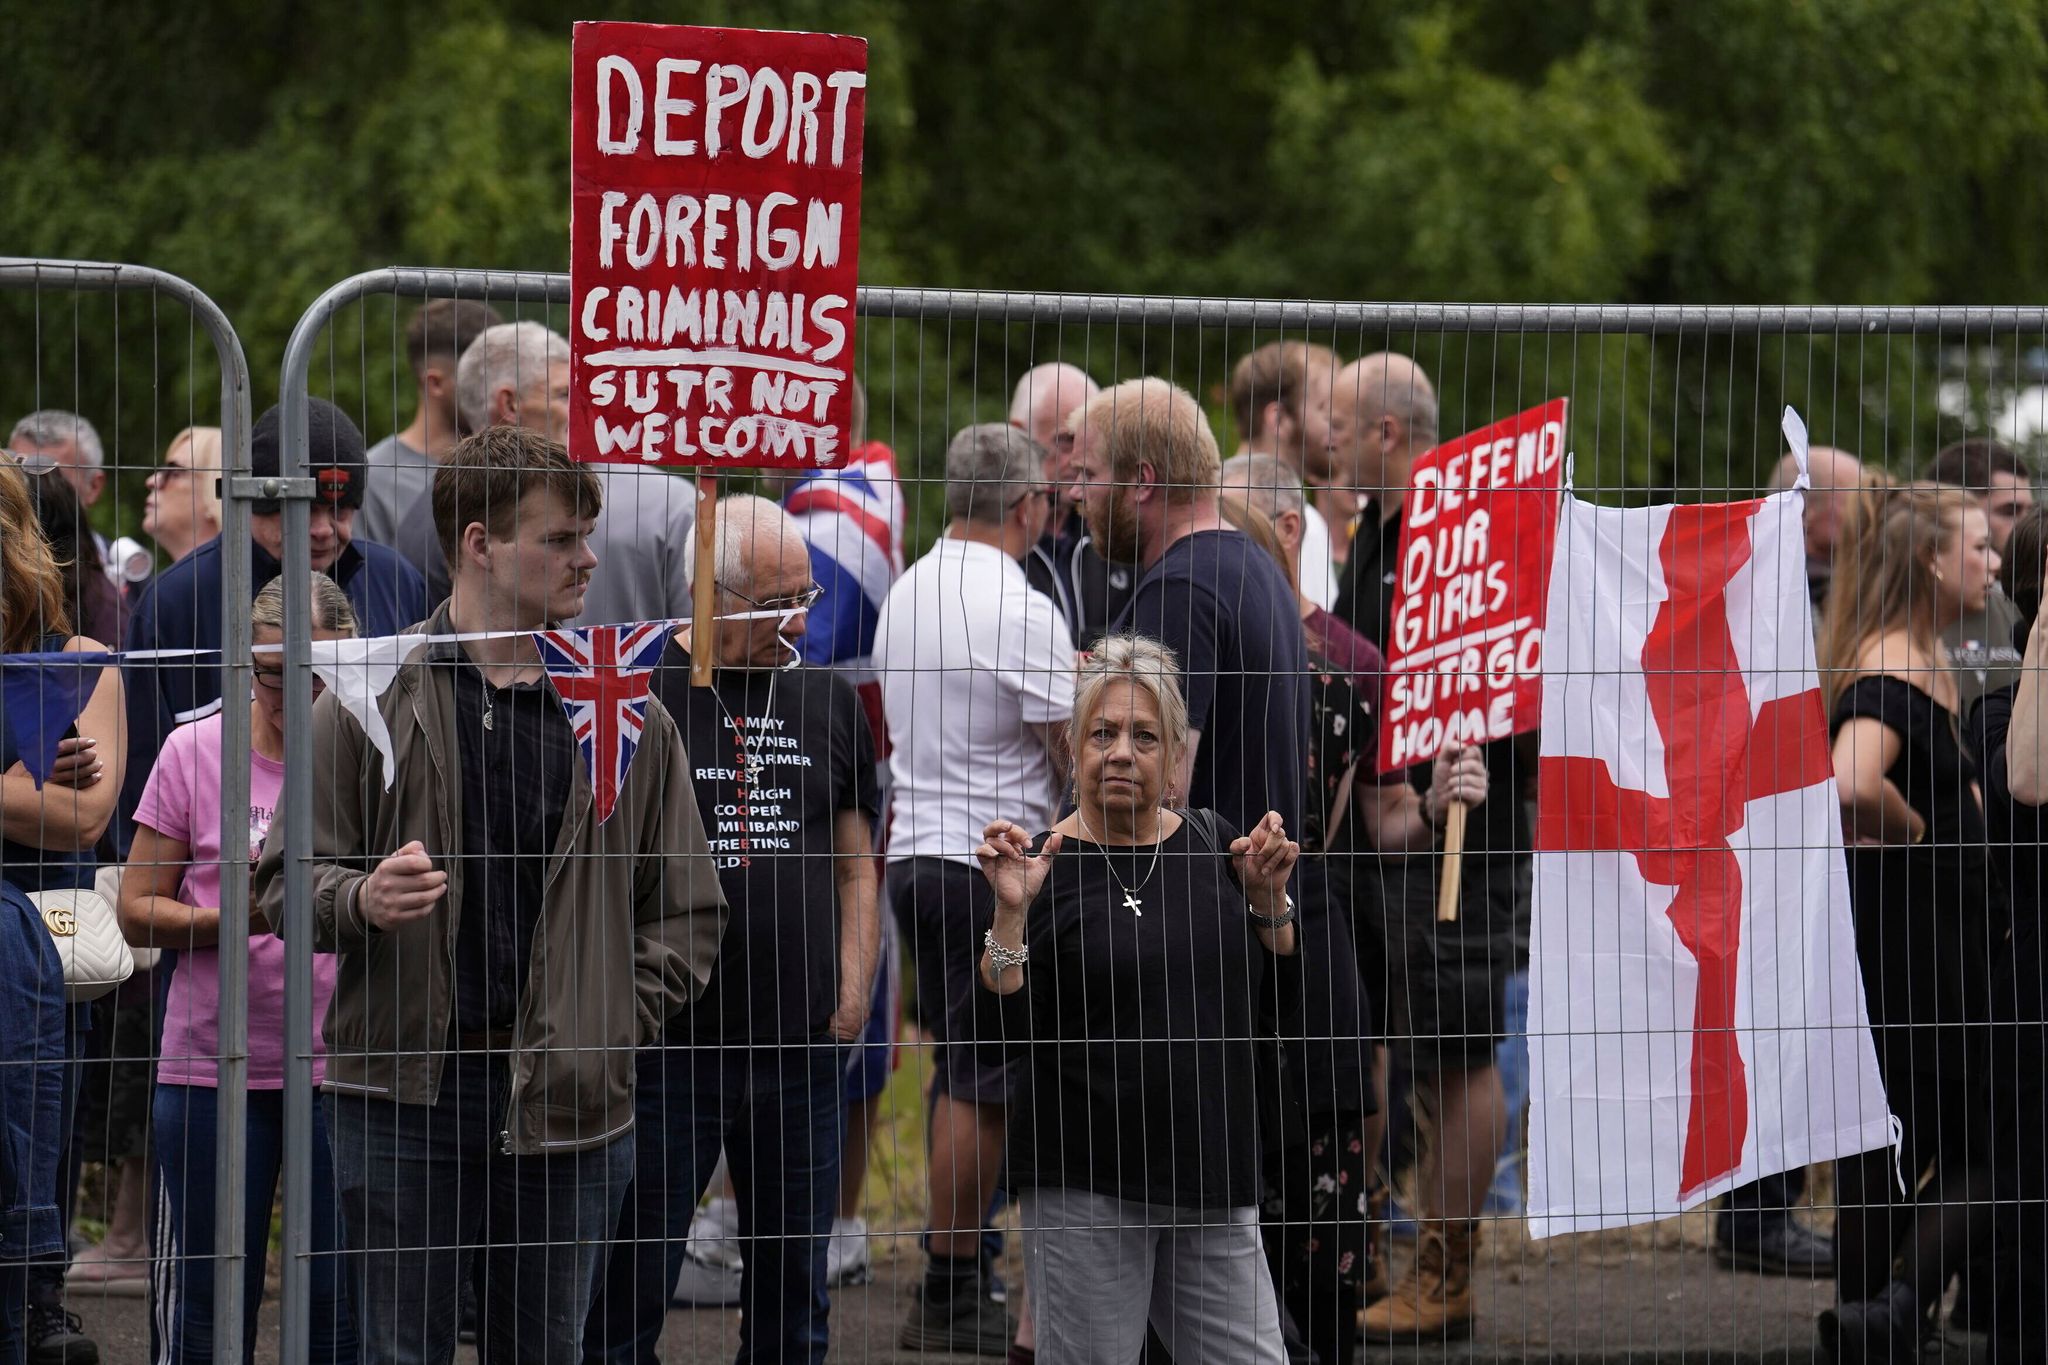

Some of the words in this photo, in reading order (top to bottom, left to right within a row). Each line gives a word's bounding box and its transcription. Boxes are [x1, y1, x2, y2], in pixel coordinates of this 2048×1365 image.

[597, 55, 866, 168] DEPORT
[600, 190, 842, 273] FOREIGN
[581, 285, 847, 363] CRIMINALS
[589, 366, 735, 416] SUTR
[750, 370, 840, 423] NOT
[594, 412, 840, 467] WELCOME
[1408, 421, 1561, 529] DEFEND
[1402, 508, 1490, 598] OUR
[1394, 560, 1508, 654] GIRLS
[1389, 647, 1482, 723] SUTR
[1487, 628, 1545, 690] GO
[724, 717, 785, 731] LAMMY
[735, 735, 798, 749] RAYNER
[1391, 692, 1516, 767] HOME
[695, 768, 754, 784] REEVES
[736, 753, 812, 767] STARMER
[714, 804, 782, 817] COOPER
[737, 787, 791, 800] HAIGH
[707, 838, 790, 852] TREETING
[718, 820, 800, 833] MILIBAND
[713, 857, 751, 869] LDS
